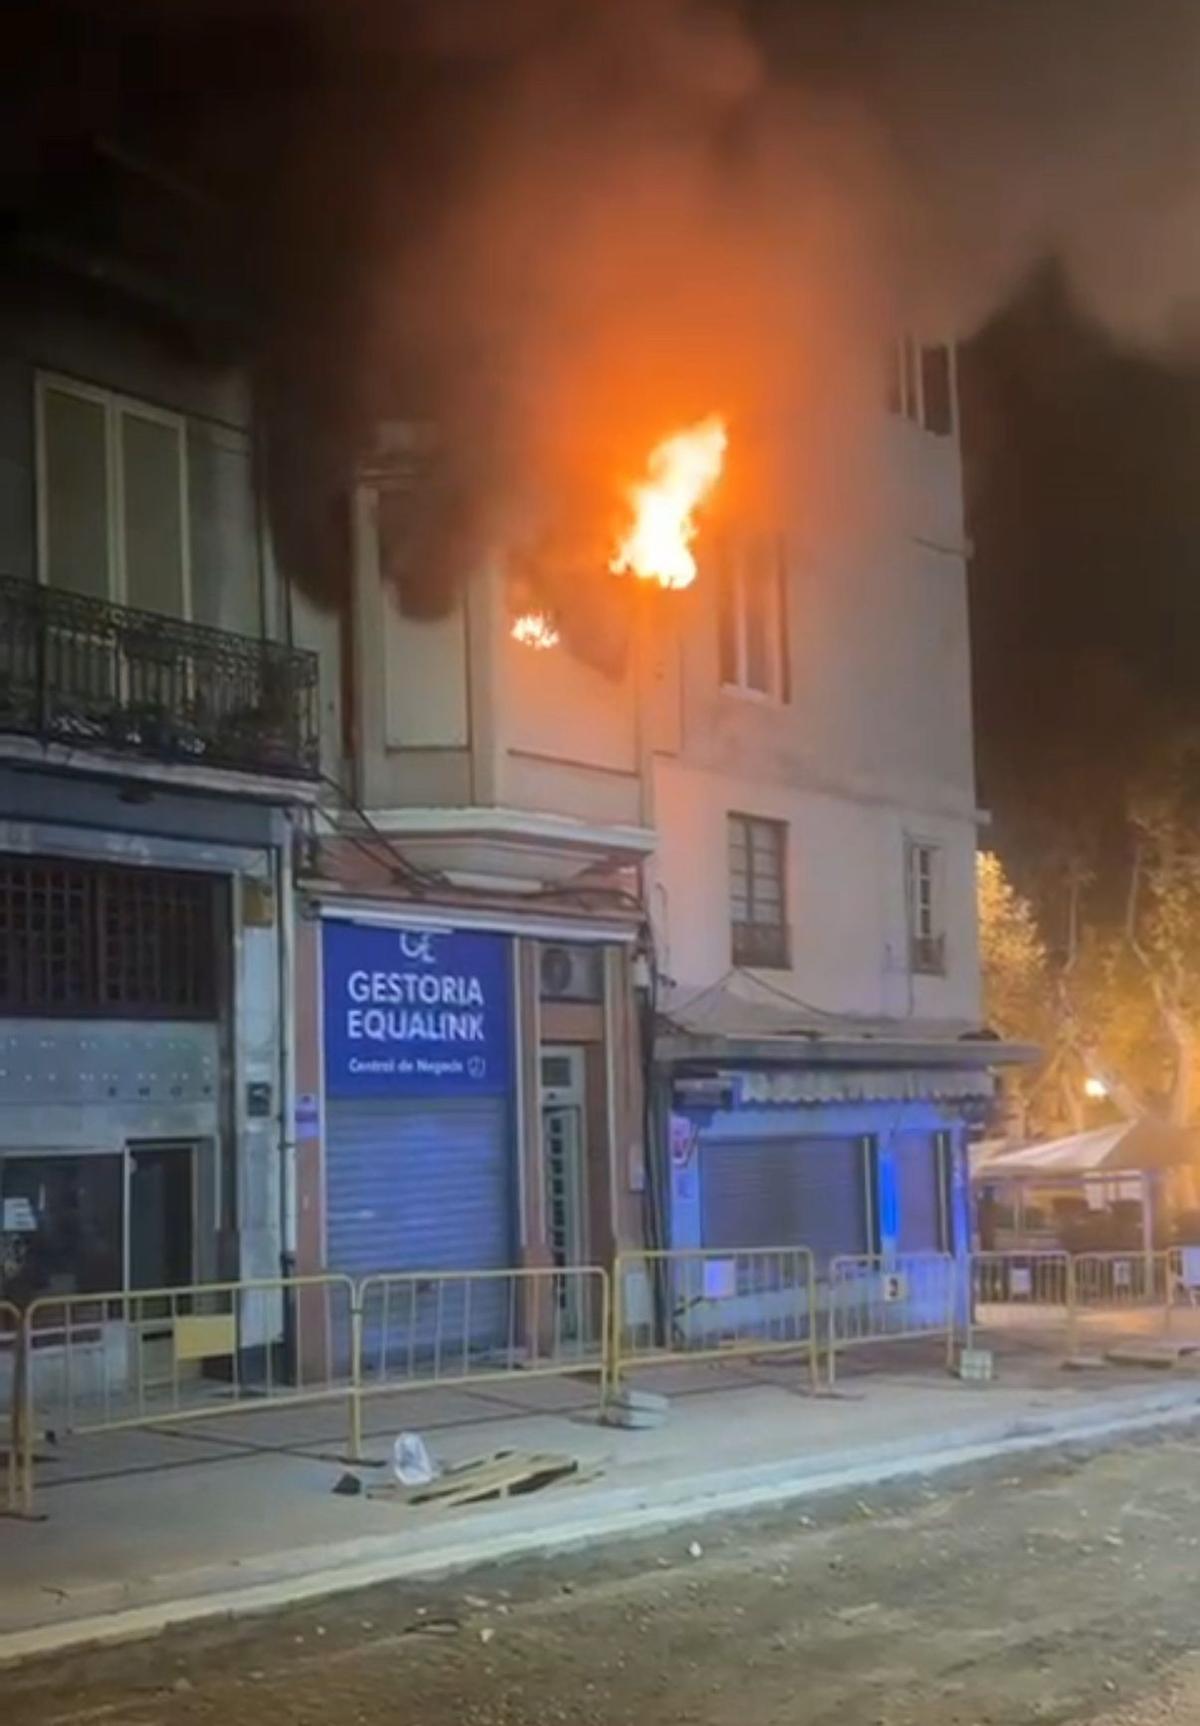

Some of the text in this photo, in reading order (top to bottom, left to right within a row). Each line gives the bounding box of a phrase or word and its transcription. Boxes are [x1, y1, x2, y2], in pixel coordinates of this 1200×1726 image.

[348, 971, 484, 1006] GESTORIA
[347, 1009, 485, 1041] EQUALINK
[397, 1059, 413, 1073] de
